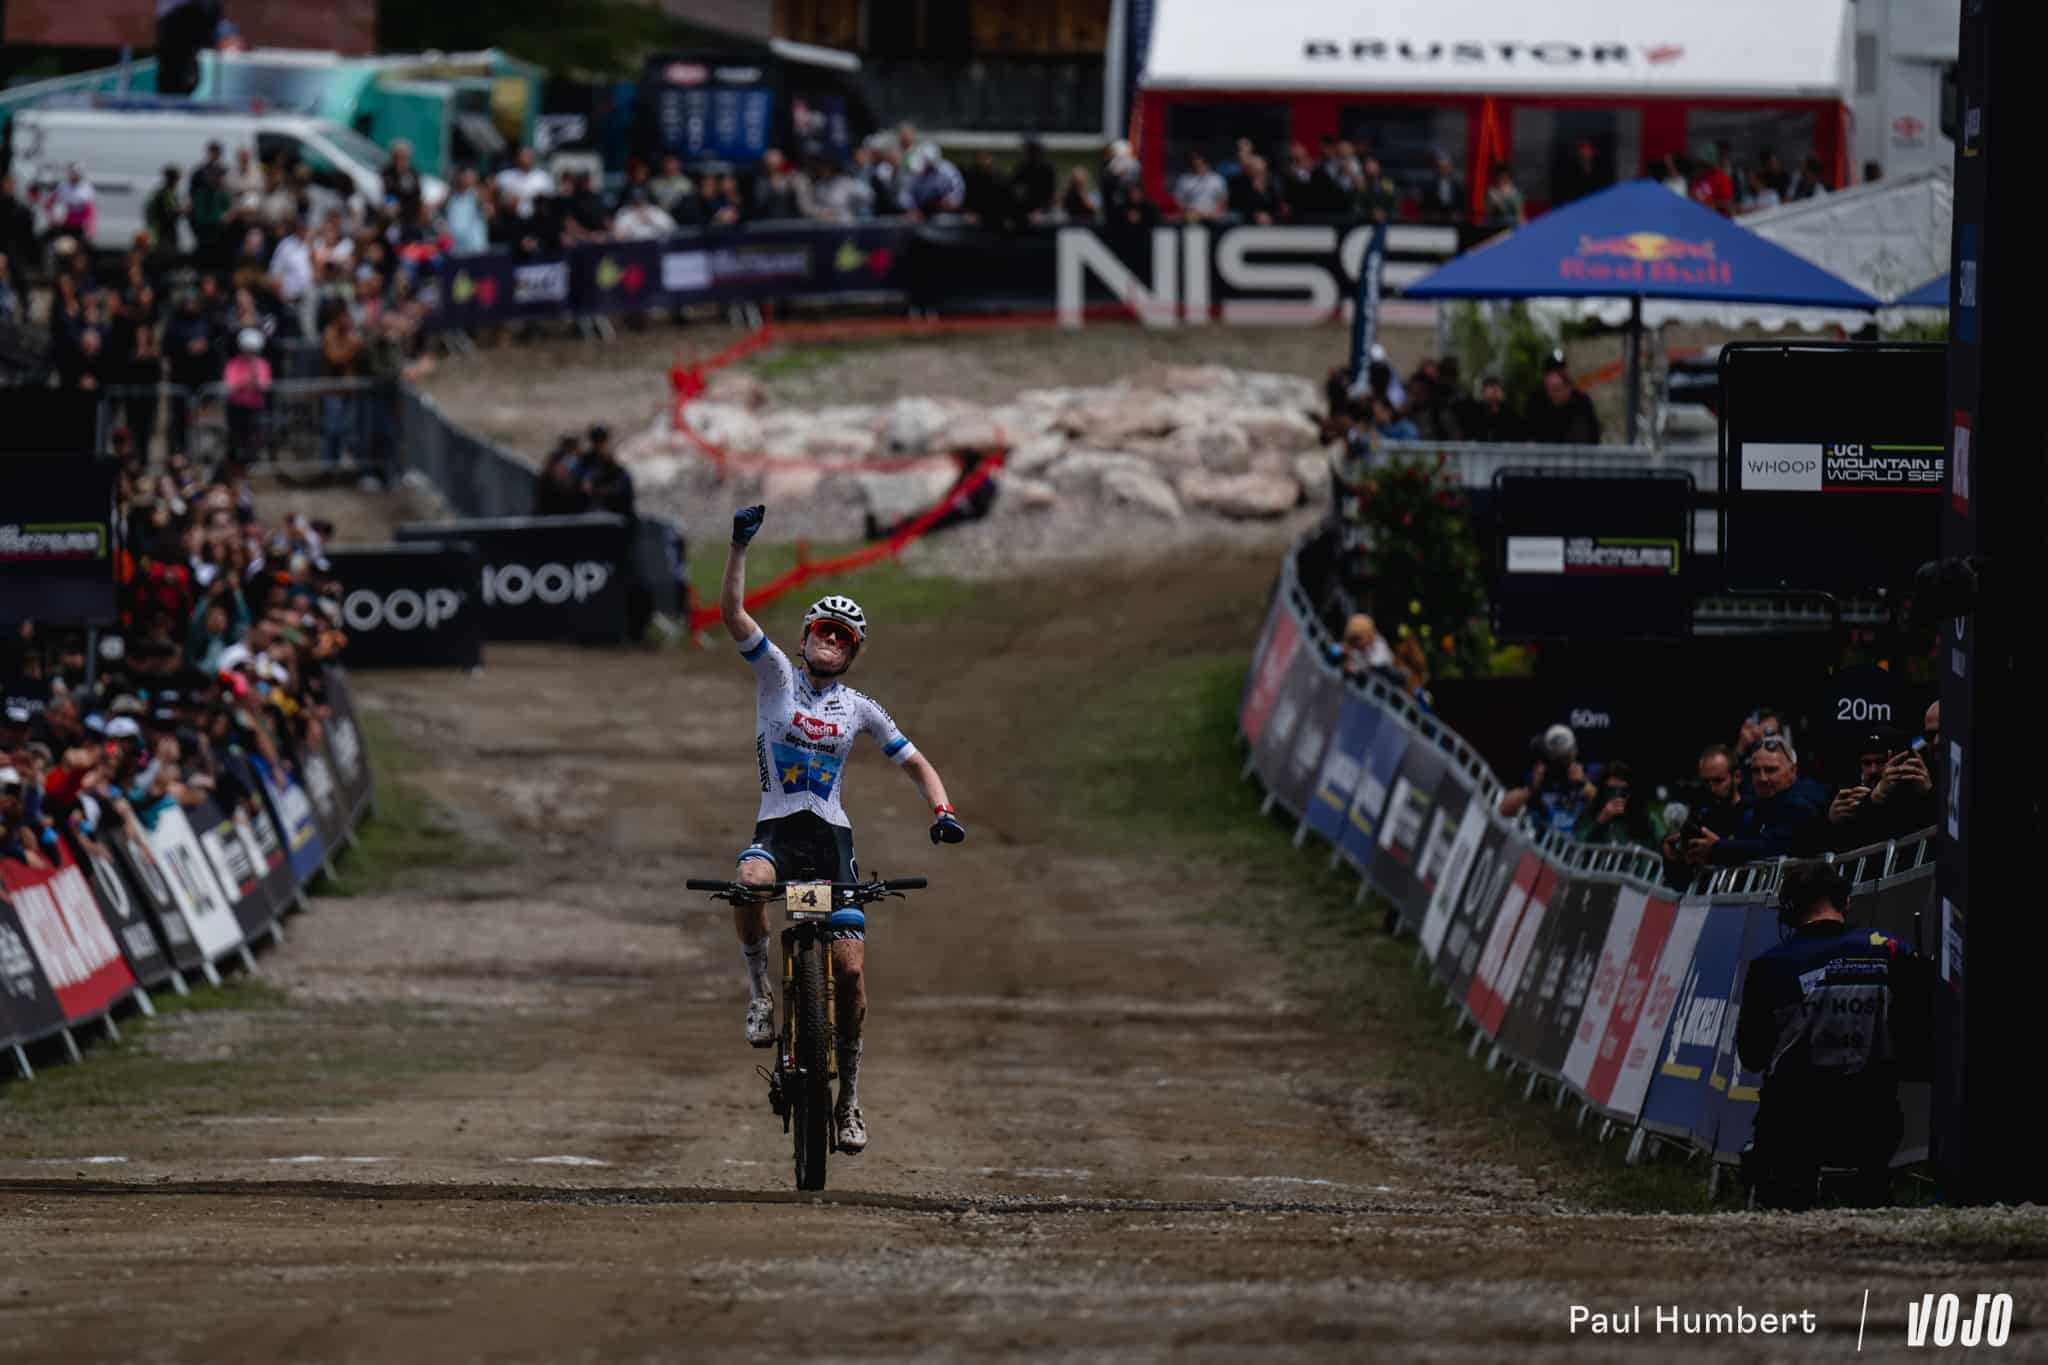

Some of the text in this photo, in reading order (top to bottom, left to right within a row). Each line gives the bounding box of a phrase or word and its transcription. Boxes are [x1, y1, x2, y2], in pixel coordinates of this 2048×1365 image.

[1305, 38, 1629, 64] BRUSTOR
[1560, 256, 1731, 285] Red Bull
[1833, 443, 1863, 457] UCI
[1748, 460, 1817, 475] WHOOP
[1826, 458, 1930, 471] MOUNTAIN
[1826, 470, 1902, 482] WORLD
[1837, 697, 1891, 721] 20m
[799, 715, 833, 739] Alpecin
[801, 890, 817, 906] 4
